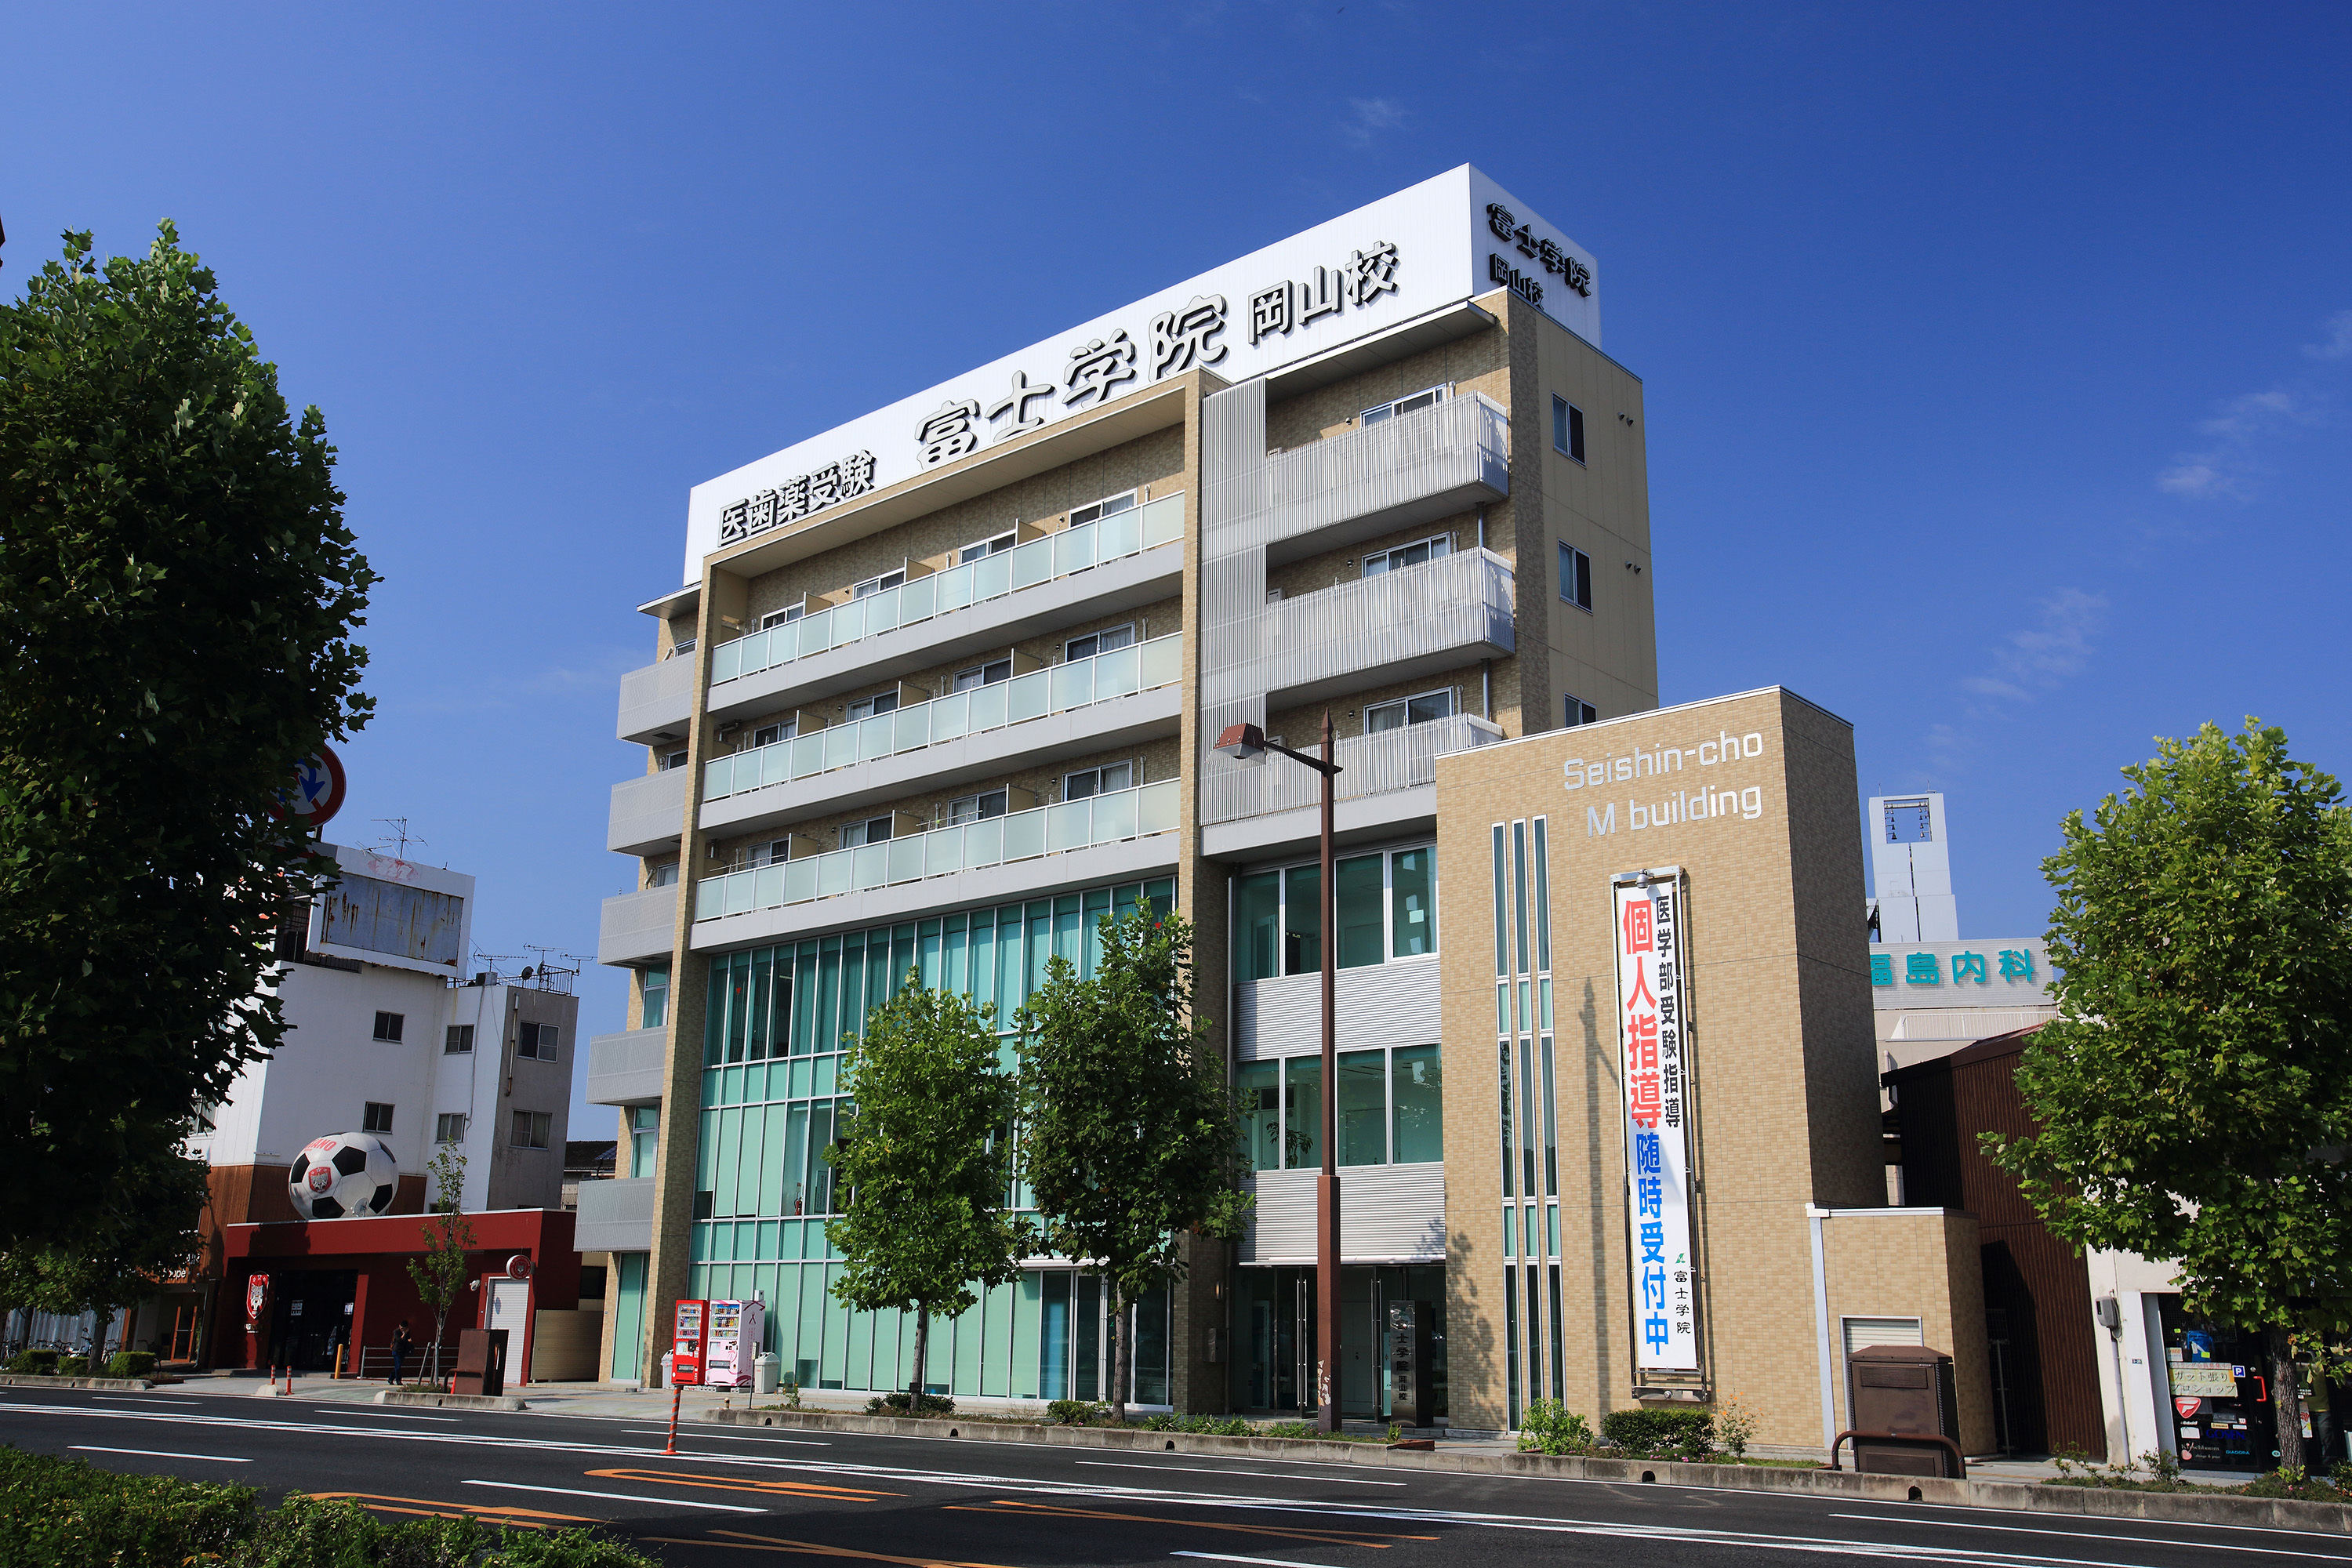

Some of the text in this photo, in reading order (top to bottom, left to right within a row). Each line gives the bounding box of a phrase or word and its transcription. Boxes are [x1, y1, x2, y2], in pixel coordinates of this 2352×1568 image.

[1486, 202, 1592, 298] 富士学院
[1490, 253, 1544, 310] 岡山校
[717, 241, 1401, 547] 医歯薬受験 富士学院 岡山校
[1564, 730, 1763, 791] Seishin-cho
[1587, 785, 1762, 837] M building
[1656, 895, 1680, 1128] 医学部受験指導
[1674, 1270, 1691, 1334] 富士学院
[2172, 1382, 2236, 1394] プロショップ
[2174, 1371, 2227, 1382] ガット張り
[2205, 1428, 2245, 1440] GOSEN
